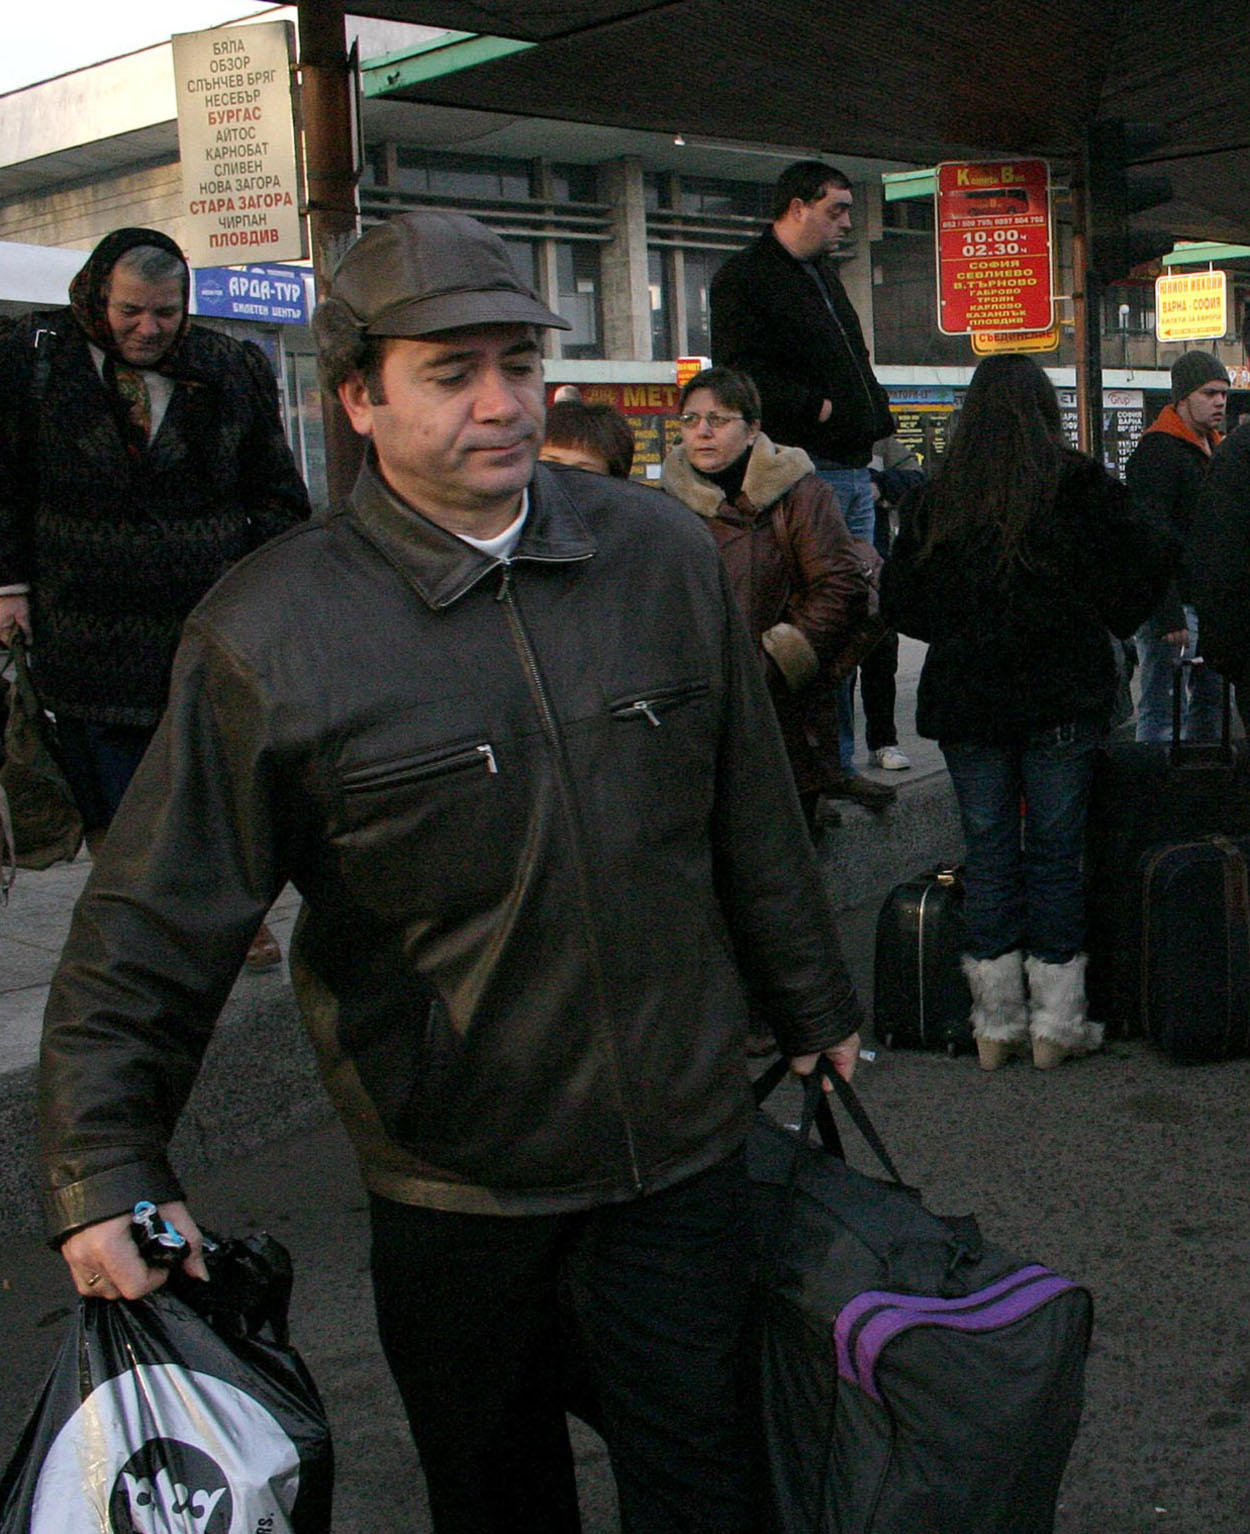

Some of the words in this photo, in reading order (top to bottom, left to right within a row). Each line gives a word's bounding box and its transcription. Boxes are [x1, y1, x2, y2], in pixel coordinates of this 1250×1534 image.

[213, 40, 245, 55] БЯЛА
[209, 56, 250, 72] ОБЗОР
[187, 74, 244, 92] СЛЪНЧЕВ
[247, 70, 276, 85] БРЯГ
[205, 89, 261, 107] НЕСЕБЪР
[208, 106, 262, 125] БУРГАС
[216, 126, 256, 143] АЙТОС
[206, 142, 269, 160] КАРНОБАТ
[214, 160, 263, 177] СЛИВЕН
[200, 180, 233, 195] НОВА
[236, 175, 281, 192] ЗАГОРА
[190, 198, 236, 215] СТАРА
[239, 192, 293, 210] ЗАГОРА
[218, 213, 267, 229] ЧИРПАН
[209, 229, 279, 248] ПЛОВДИВ
[969, 260, 1020, 269] СОФИЯ
[956, 269, 1033, 280] СЕВЛИЕВО
[229, 276, 301, 302] АРДА-ТУР
[970, 288, 1022, 296] ГАБРОВО
